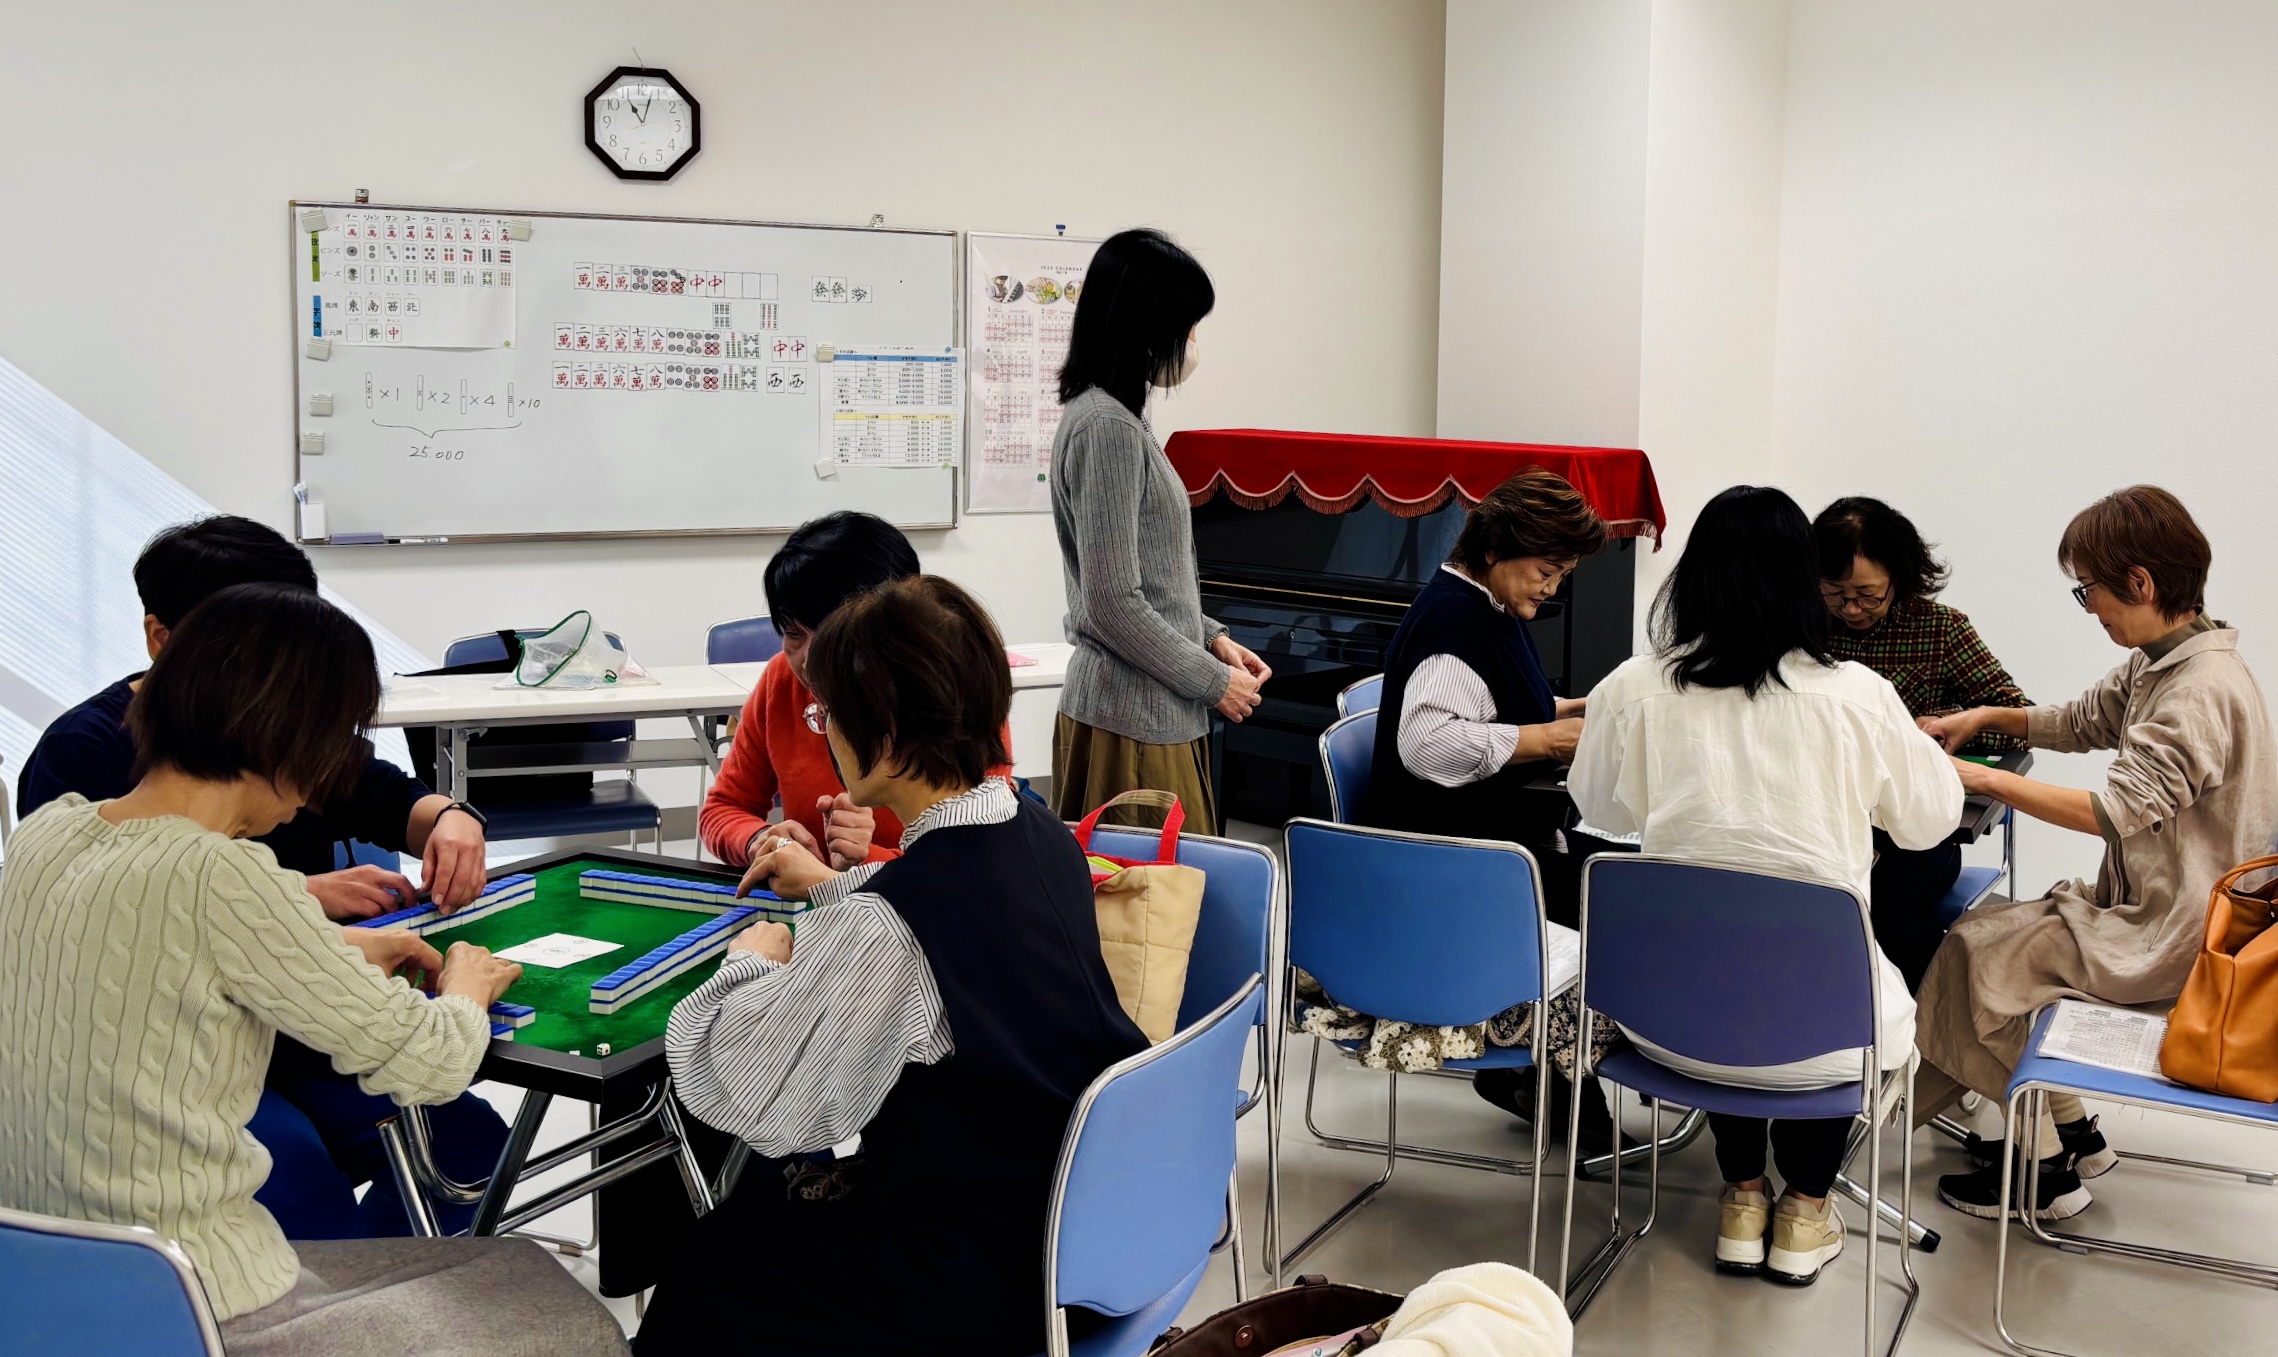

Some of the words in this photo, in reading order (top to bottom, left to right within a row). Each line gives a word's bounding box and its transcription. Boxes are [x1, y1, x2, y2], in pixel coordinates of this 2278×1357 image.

[637, 83, 648, 96] 12
[607, 98, 620, 111] 10
[669, 101, 676, 114] 2
[603, 116, 611, 129] 9
[674, 120, 681, 133] 3
[609, 135, 617, 147] 8
[668, 139, 675, 150] 4
[623, 148, 630, 160] 7
[639, 152, 646, 165] 6
[656, 149, 663, 162] 5
[690, 274, 705, 294] 中
[708, 275, 722, 294] 中
[348, 299, 359, 312] 東
[368, 300, 379, 312] 南
[388, 302, 398, 312] 西
[407, 302, 418, 312] 北
[389, 327, 399, 340] 中
[773, 340, 788, 359] 中
[791, 340, 805, 359] 中
